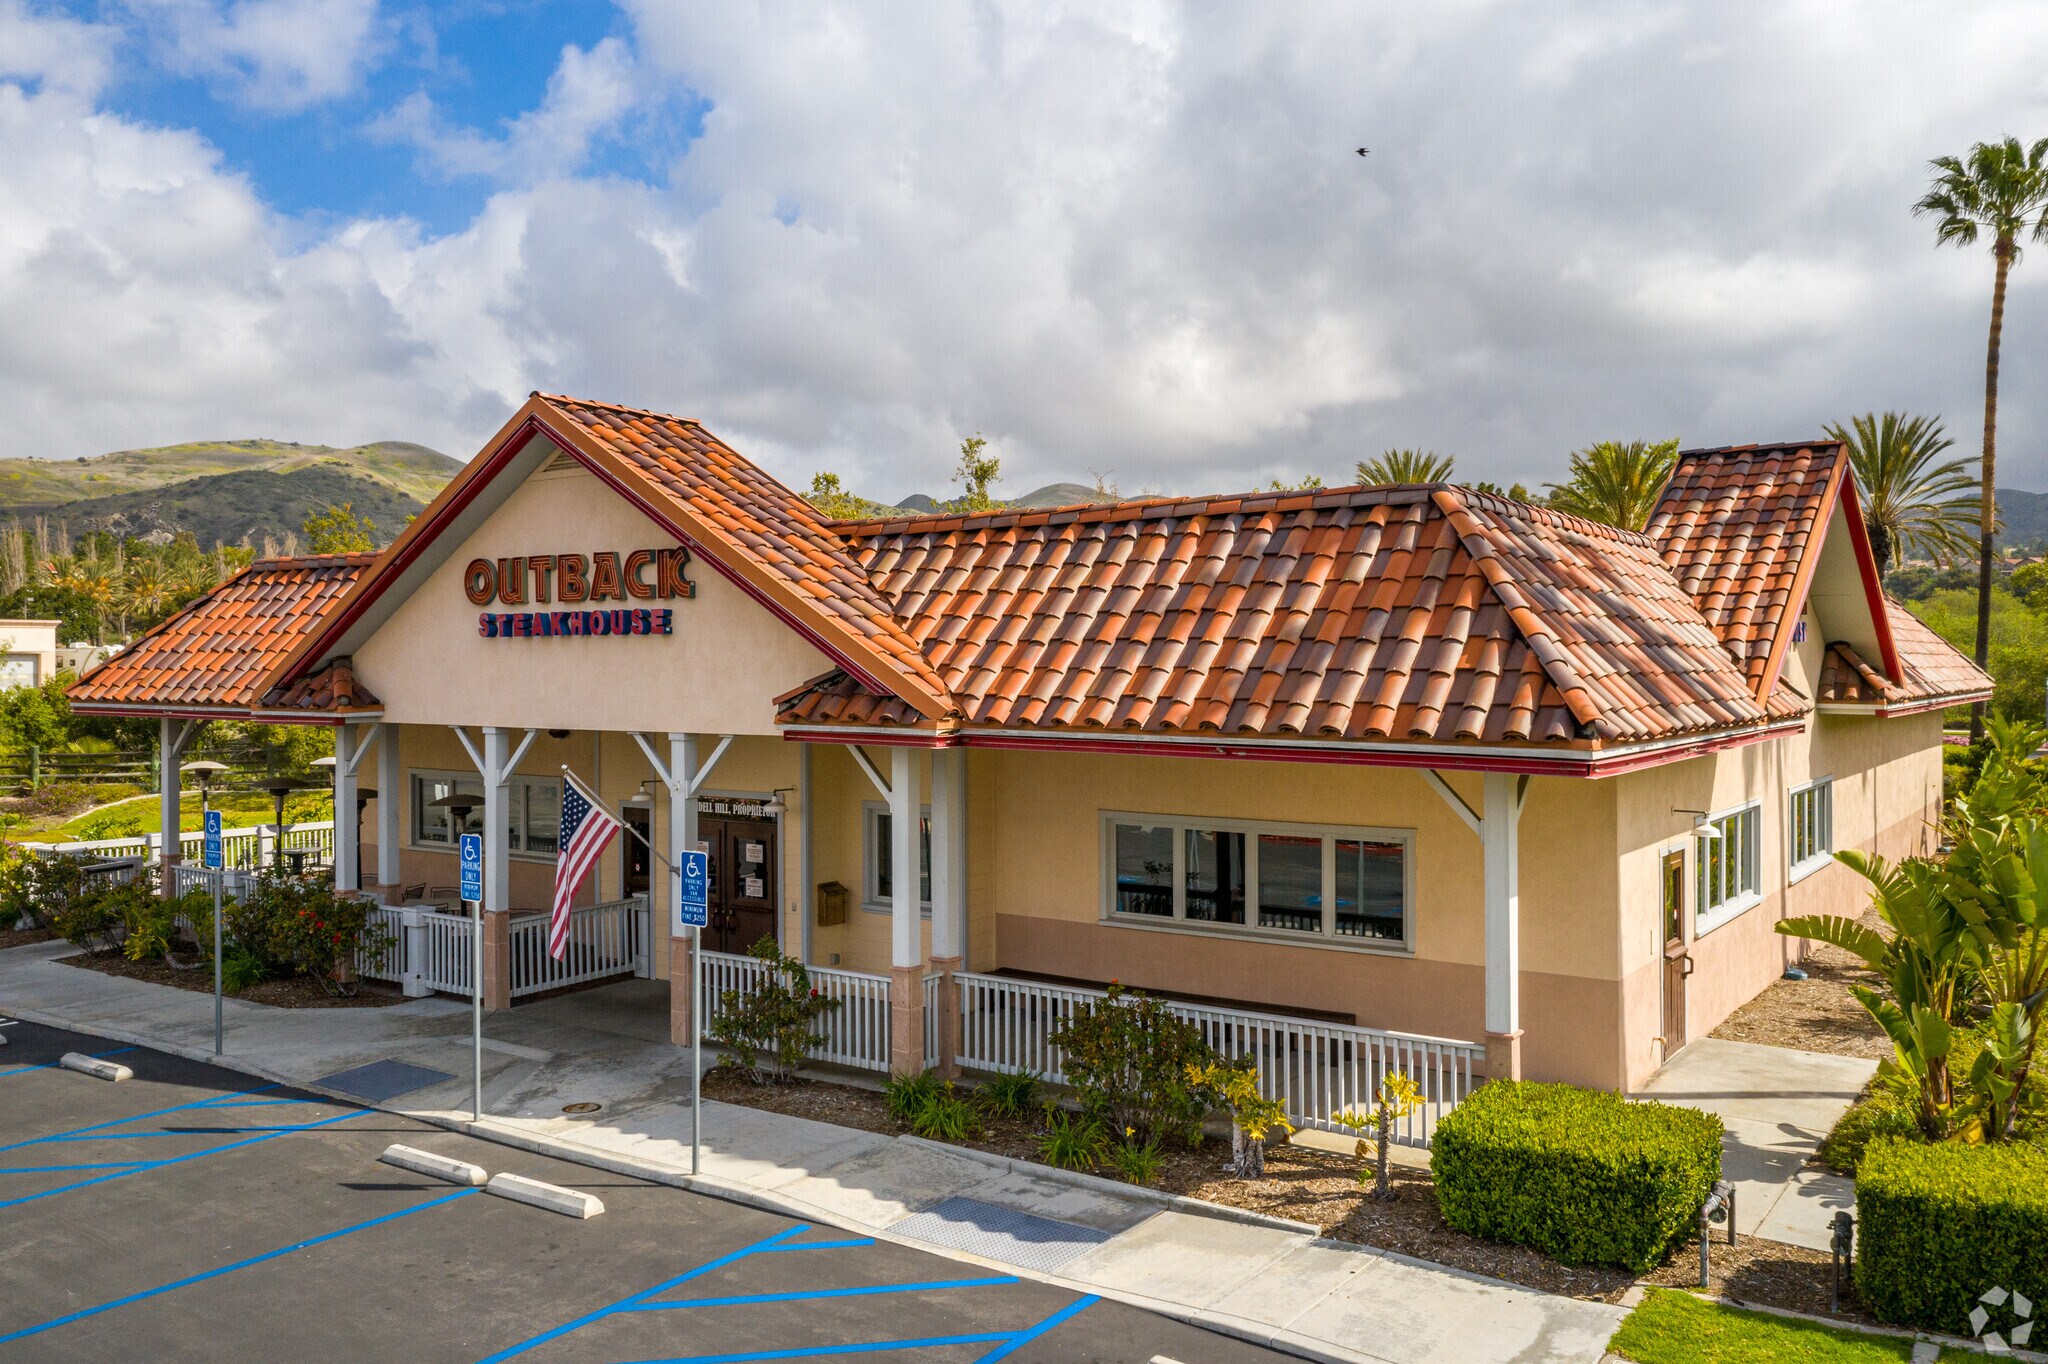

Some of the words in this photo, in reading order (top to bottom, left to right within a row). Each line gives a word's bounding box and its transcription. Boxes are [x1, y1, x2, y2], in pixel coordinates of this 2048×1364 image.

[464, 546, 696, 605] OUTBACK
[479, 608, 673, 637] STEAKHOUSE
[715, 803, 731, 815] HILL,
[462, 861, 480, 871] PARKING
[465, 871, 476, 881] ONLY
[682, 895, 704, 903] ACCESSIBLE
[684, 905, 703, 913] MINIMUM
[682, 912, 692, 920] FINE
